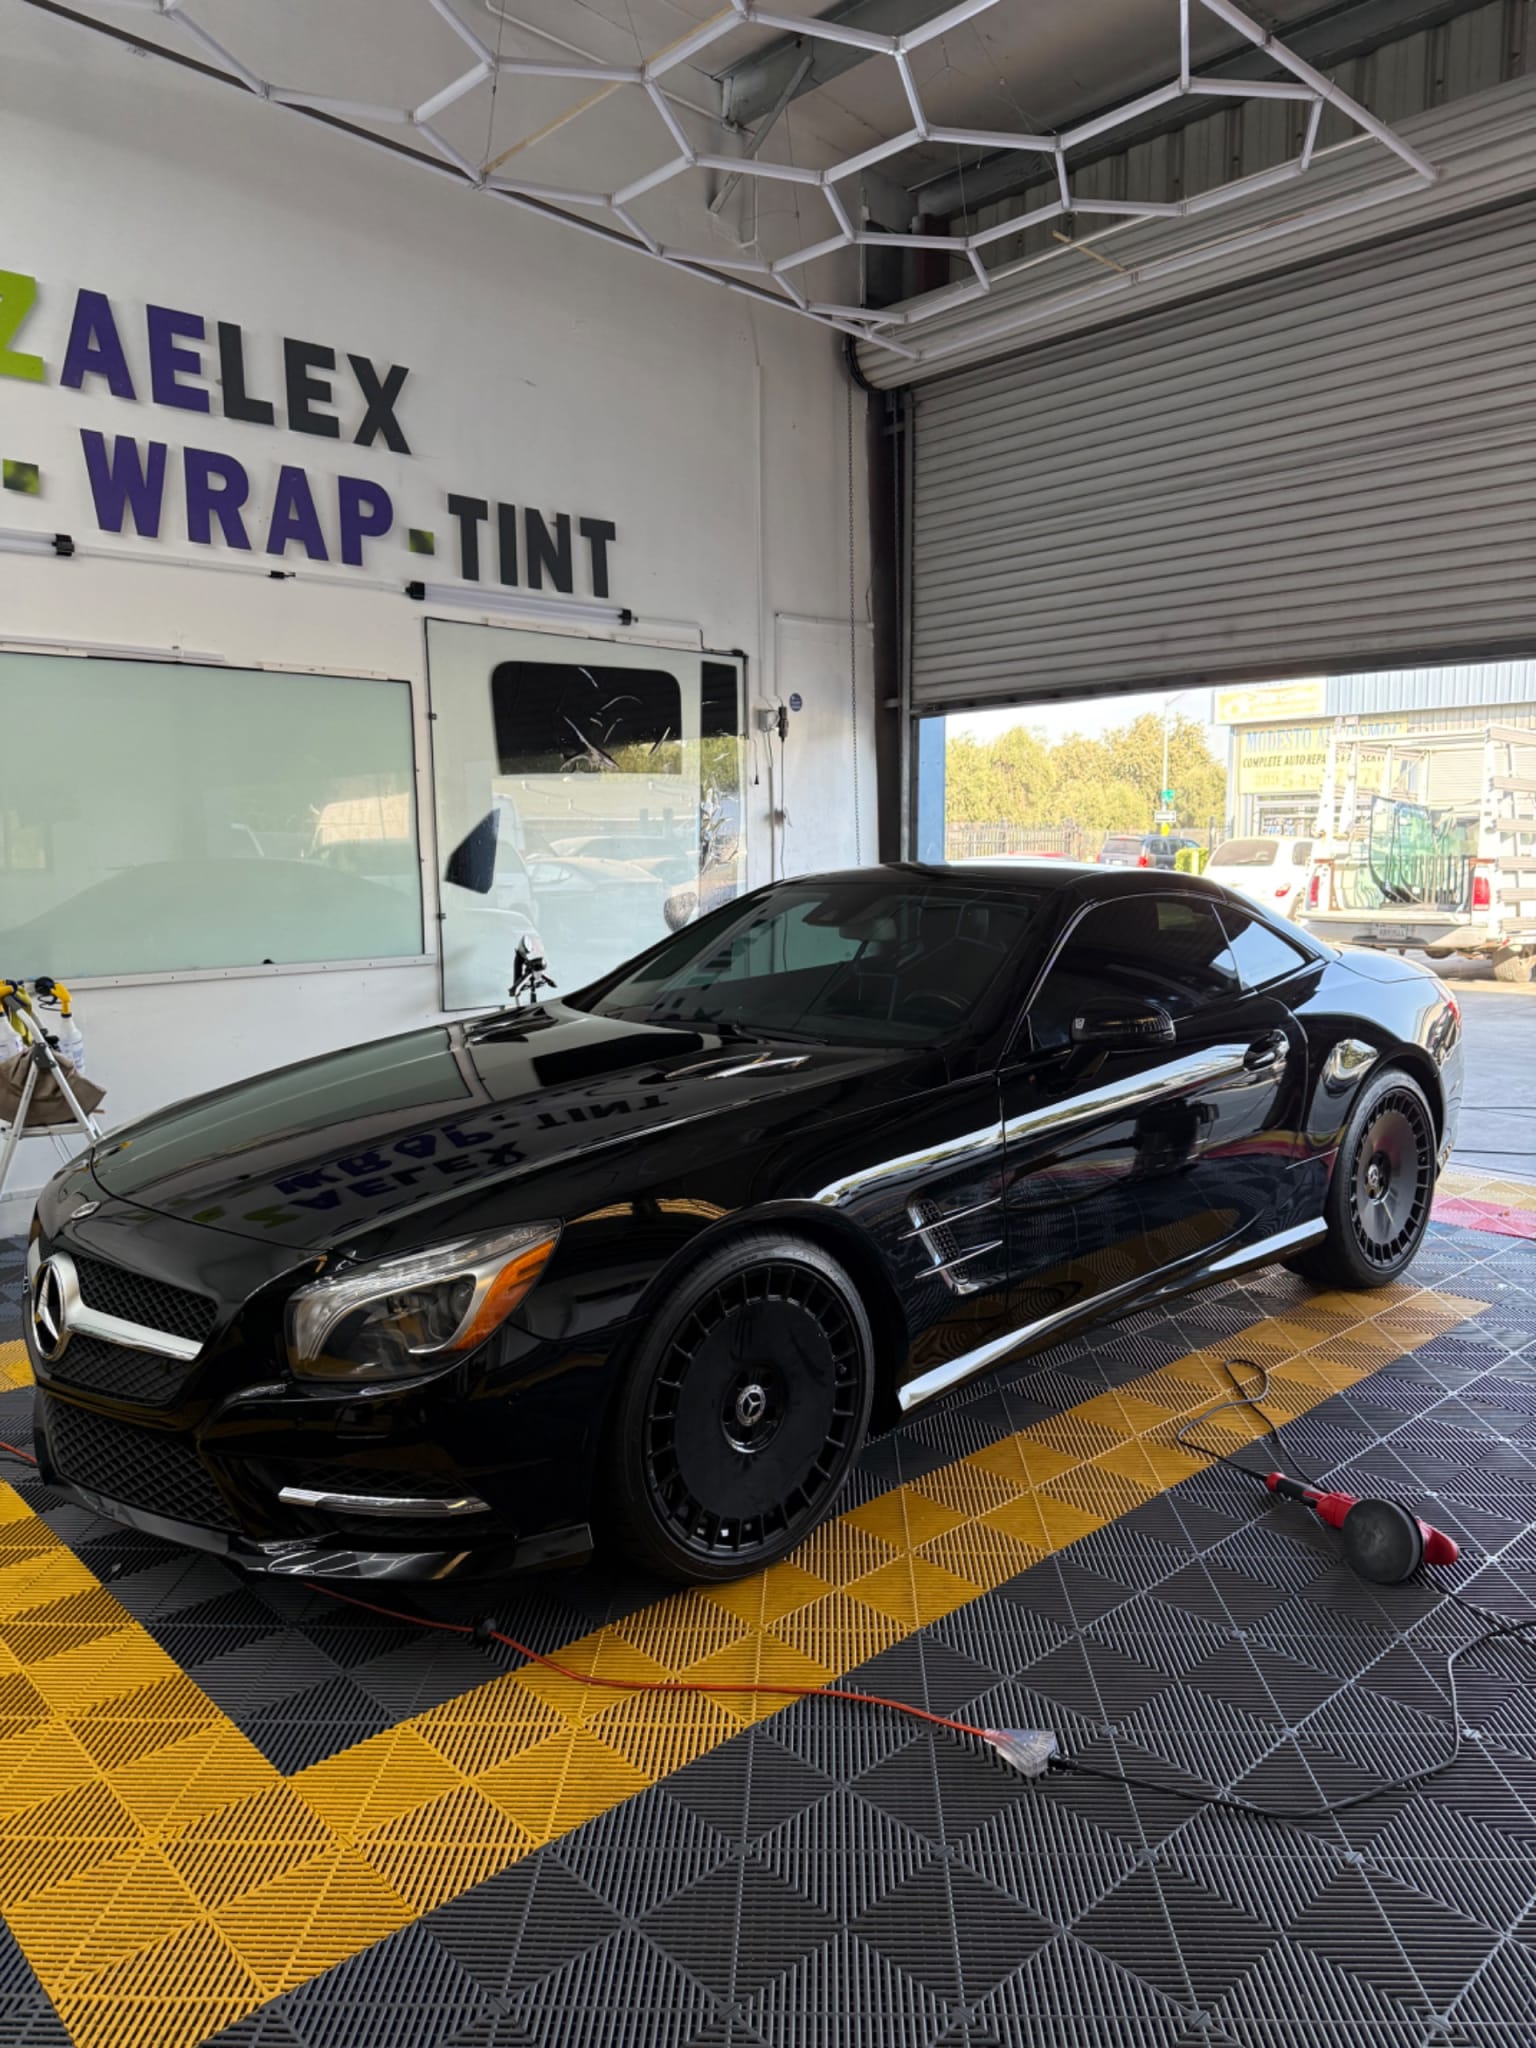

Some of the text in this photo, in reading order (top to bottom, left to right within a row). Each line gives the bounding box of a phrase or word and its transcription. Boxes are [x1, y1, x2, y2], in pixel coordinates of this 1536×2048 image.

[80, 428, 616, 599] WRAP TINT
[1246, 728, 1312, 753] MODESTO
[1243, 755, 1281, 769] COMPLETE
